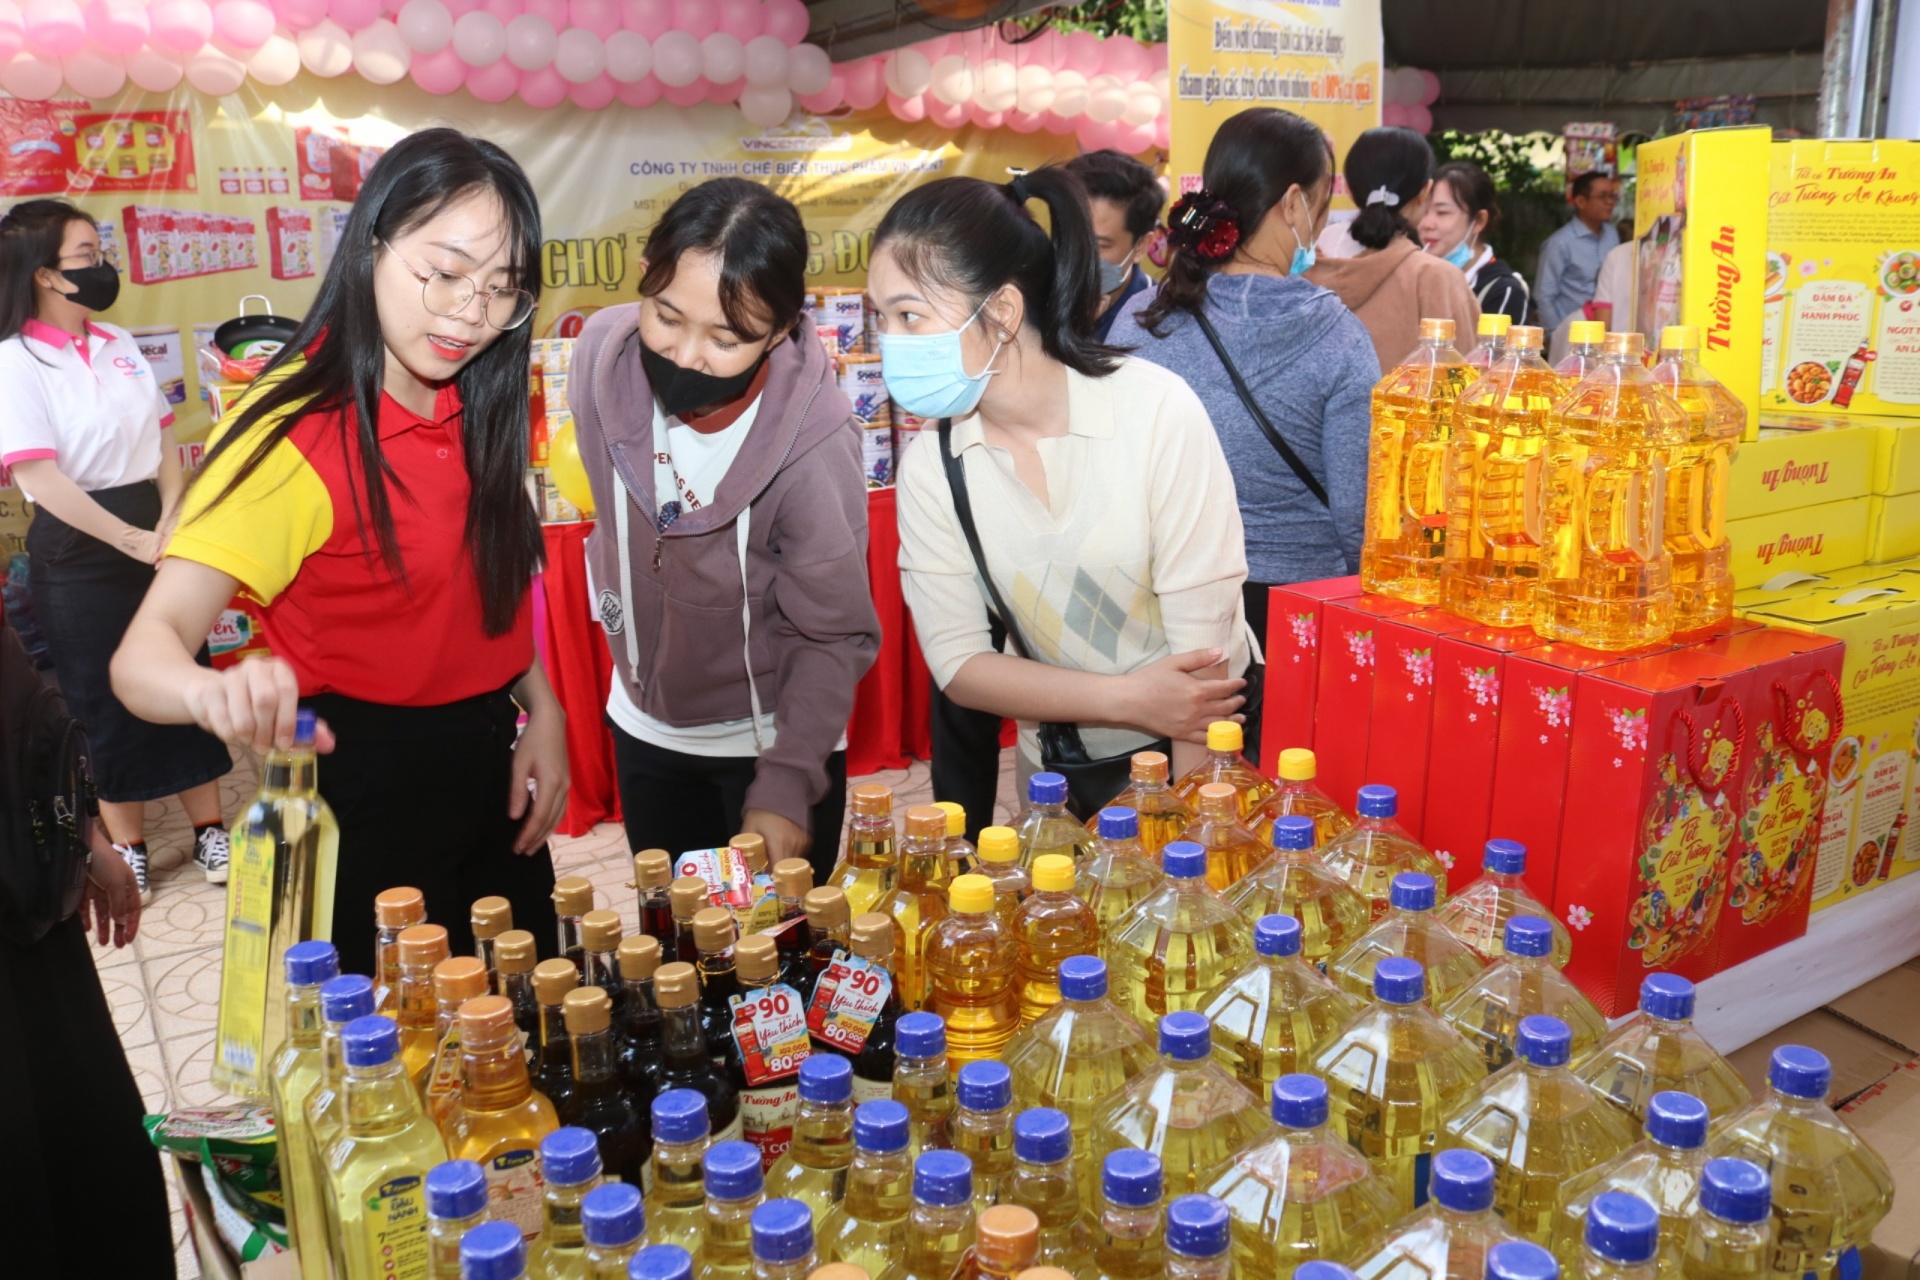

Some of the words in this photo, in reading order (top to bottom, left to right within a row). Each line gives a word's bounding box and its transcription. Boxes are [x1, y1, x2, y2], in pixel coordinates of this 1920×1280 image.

[630, 158, 675, 176] CÔNG
[680, 161, 697, 175] TY
[702, 161, 738, 175] TNHH
[1776, 781, 1795, 811] Tết
[1680, 816, 1701, 847] Tết
[1757, 813, 1778, 836] Cát
[1780, 803, 1806, 829] Tường
[1659, 850, 1683, 874] Cát
[1685, 838, 1712, 865] Tường
[1674, 882, 1693, 898] 2024
[850, 970, 880, 996] 90
[758, 993, 790, 1019] 90
[831, 993, 854, 1011] Yêu
[758, 1027, 779, 1050] Yêu
